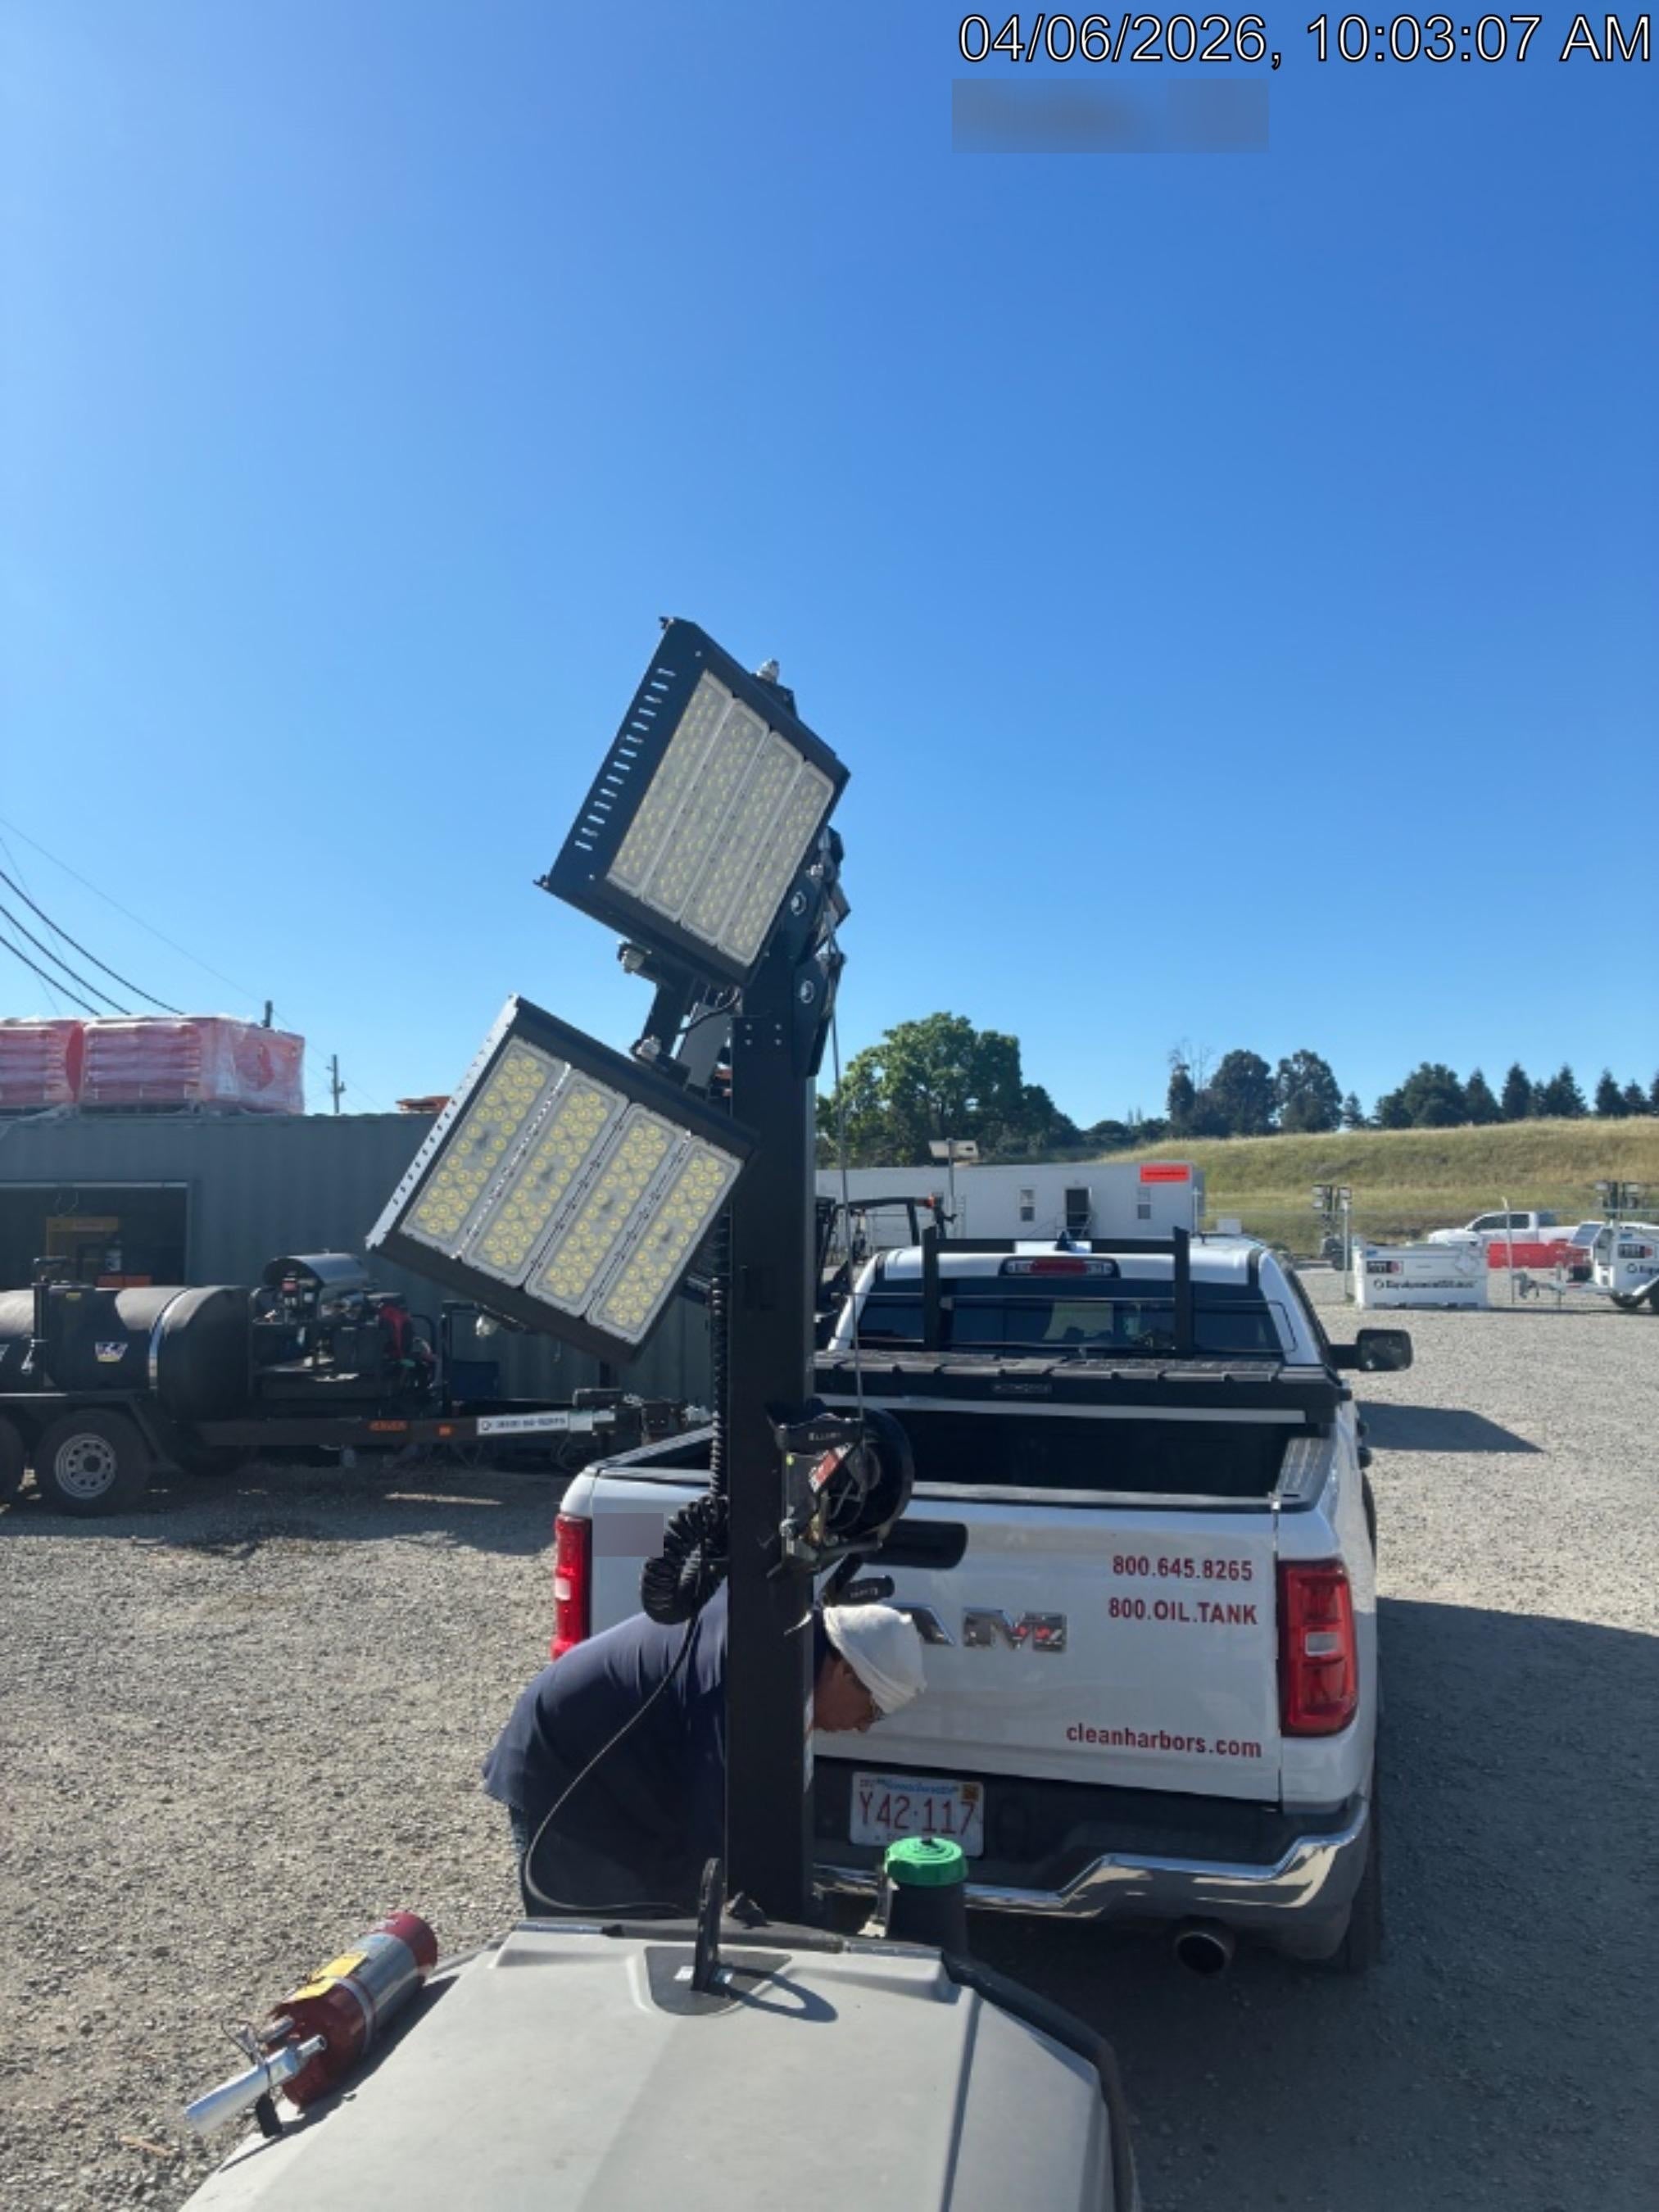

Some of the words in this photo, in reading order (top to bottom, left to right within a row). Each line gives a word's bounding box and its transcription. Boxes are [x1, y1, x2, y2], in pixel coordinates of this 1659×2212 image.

[1113, 1555, 1253, 1580] 800.645.8265
[1109, 1598, 1258, 1625] 800.OIL.TANK
[1067, 1723, 1262, 1758] cleanharbors.com
